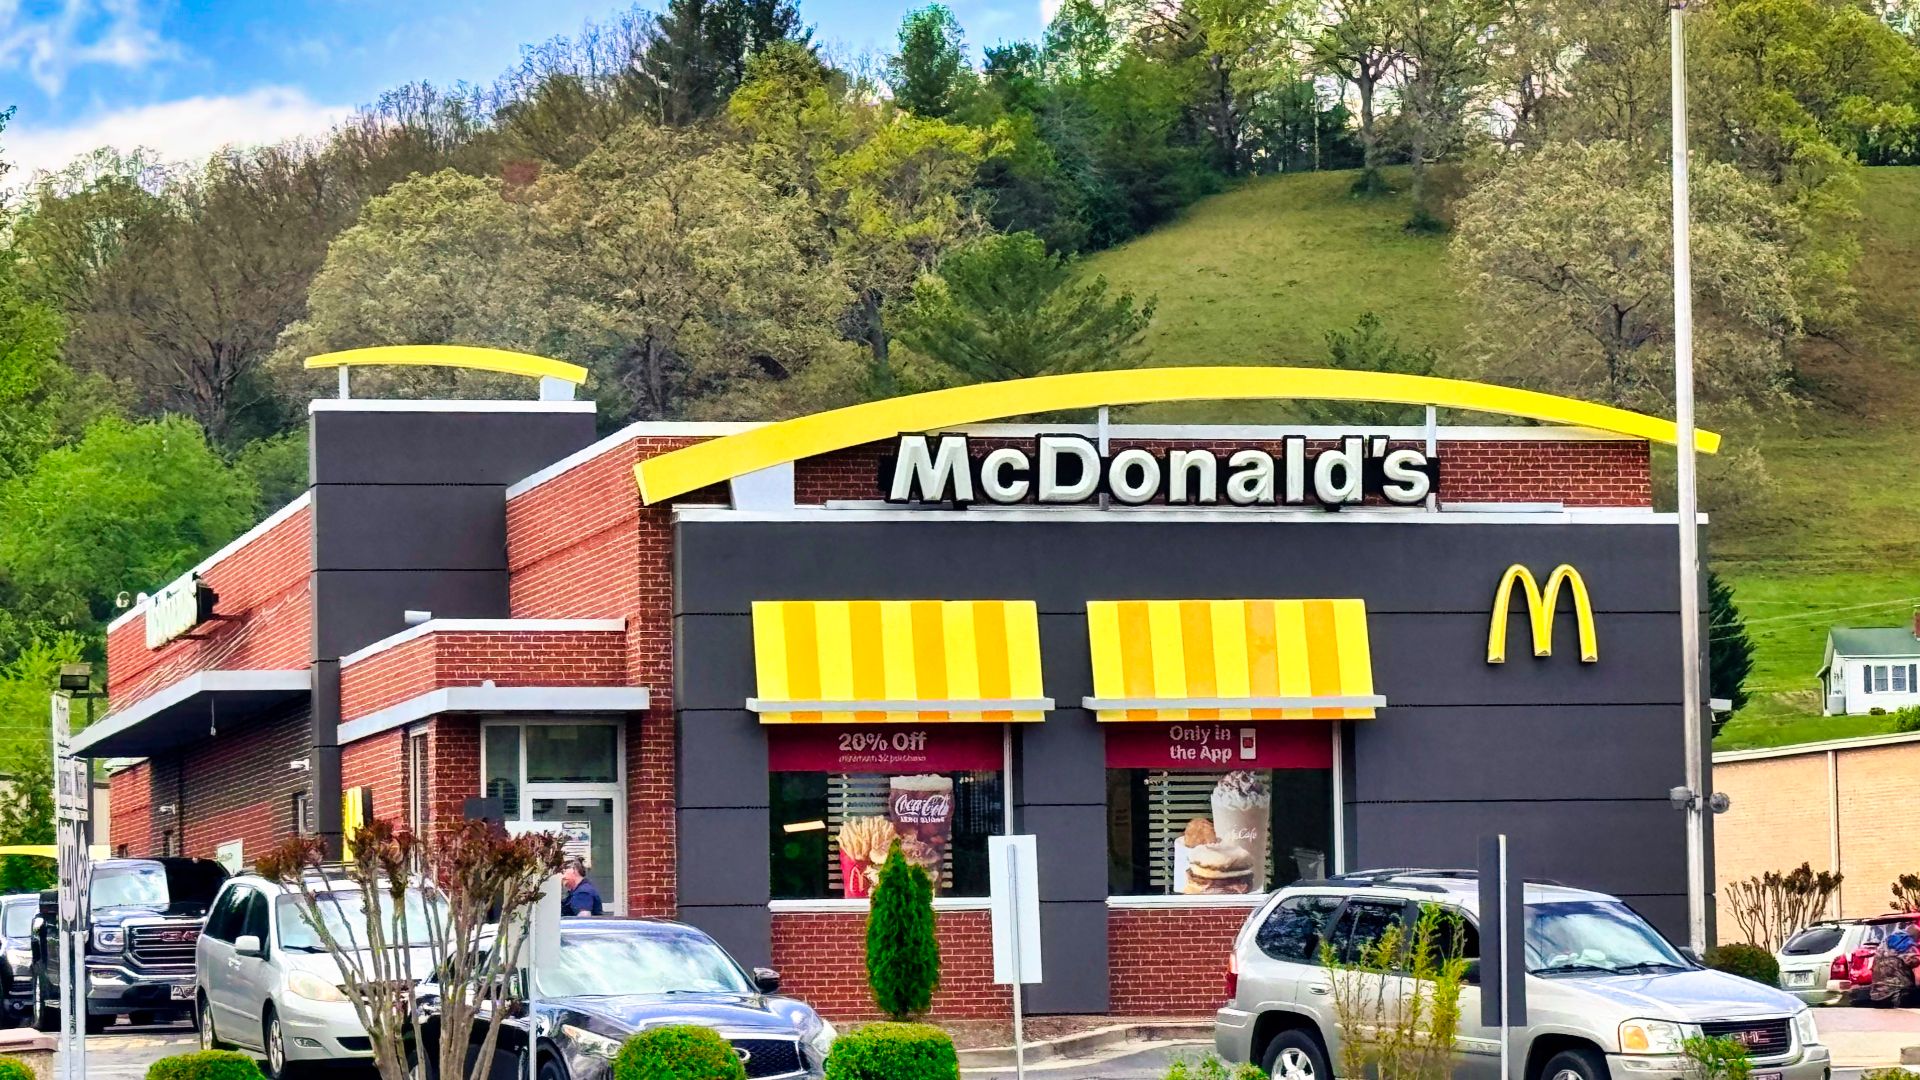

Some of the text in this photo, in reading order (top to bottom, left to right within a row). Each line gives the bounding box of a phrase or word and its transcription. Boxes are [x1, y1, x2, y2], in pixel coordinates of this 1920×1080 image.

[888, 434, 1433, 506] McDonald's
[838, 731, 927, 751] 20% Off
[1169, 724, 1232, 745] Only in
[1169, 745, 1233, 764] the App
